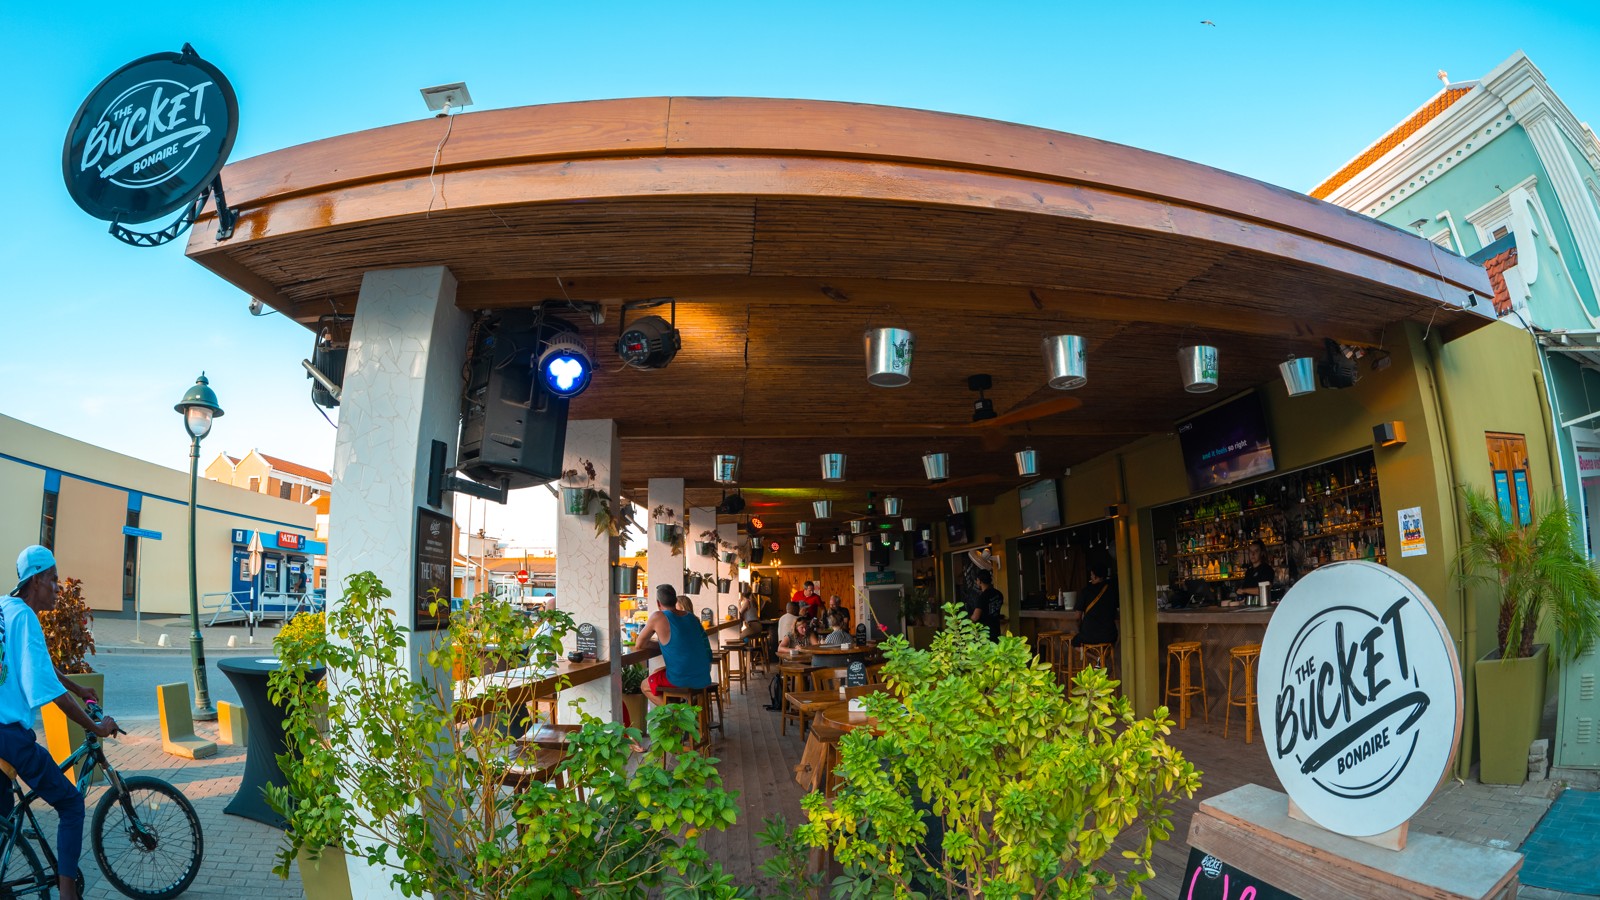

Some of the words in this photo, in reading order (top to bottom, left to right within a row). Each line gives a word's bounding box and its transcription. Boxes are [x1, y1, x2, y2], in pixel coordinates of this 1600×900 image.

[81, 81, 213, 172] BUCKET
[114, 104, 134, 122] THE
[133, 143, 179, 174] BONAIRE
[1228, 444, 1234, 452] so
[1234, 440, 1247, 449] right
[282, 534, 297, 544] ATM
[1275, 596, 1410, 759] BUCKET
[1295, 656, 1317, 685] THE
[1337, 727, 1390, 775] BONAIRE
